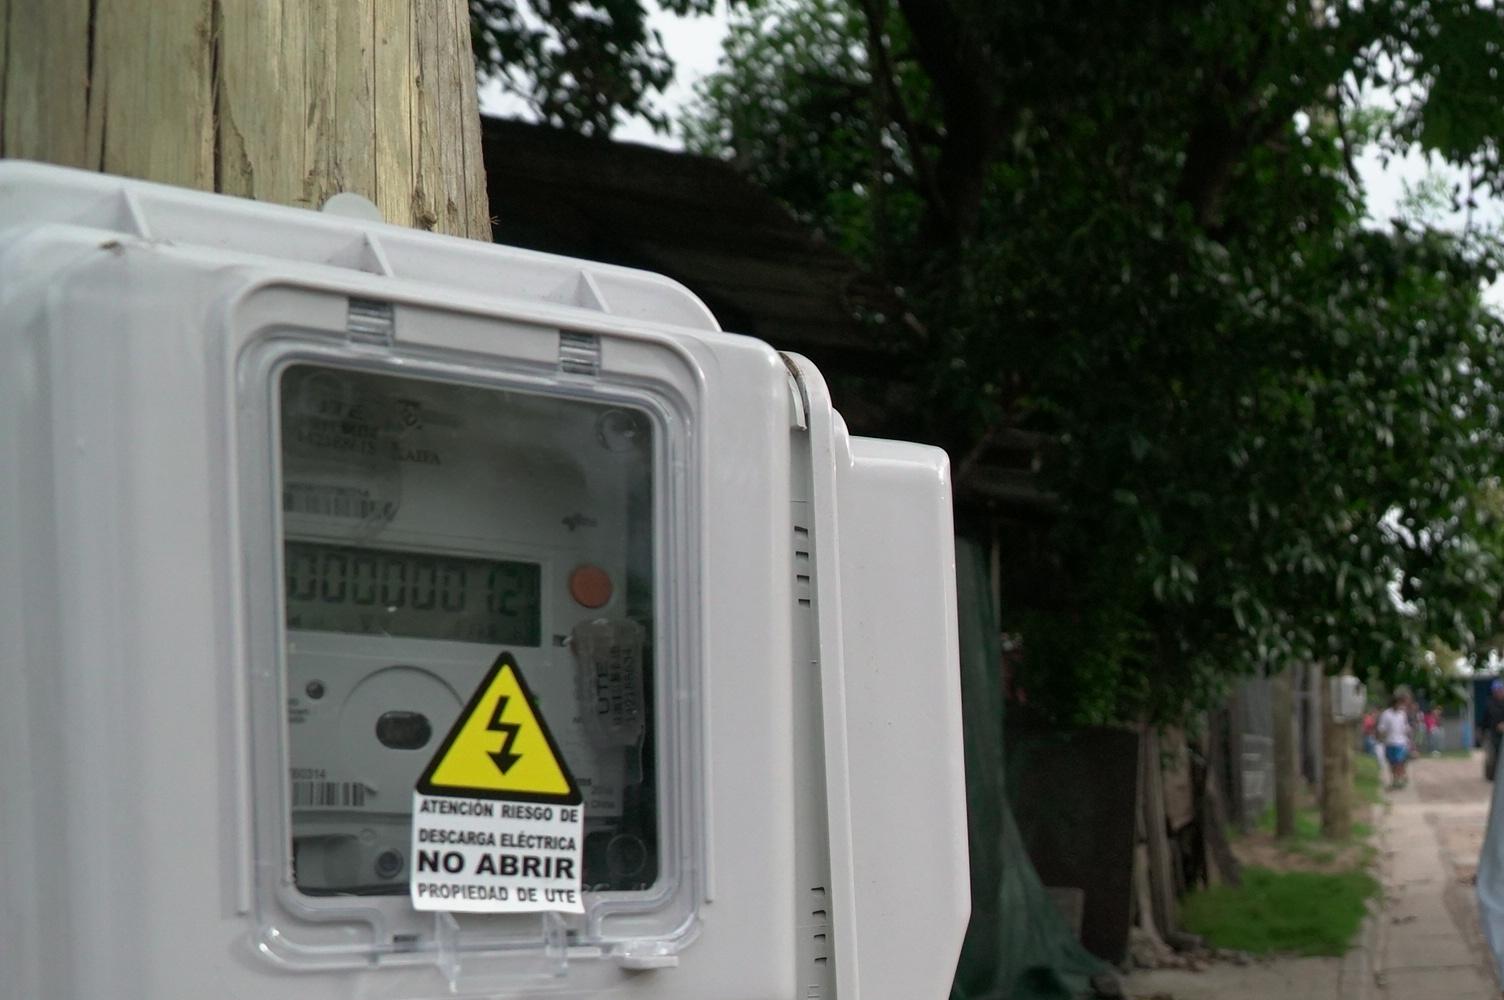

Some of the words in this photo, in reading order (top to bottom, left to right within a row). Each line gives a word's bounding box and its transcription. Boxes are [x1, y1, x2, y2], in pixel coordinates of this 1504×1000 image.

[596, 661, 609, 714] UTE
[420, 799, 493, 818] ATENCIÓN
[502, 804, 552, 821] RIESGO
[560, 809, 578, 823] DE
[419, 828, 496, 846] DESCARGA
[501, 831, 576, 850] ELÉCTRICA
[418, 849, 465, 874] NO
[475, 853, 575, 879] ABRIR
[418, 882, 508, 901] PROPIEDAD
[517, 887, 538, 902] DE
[545, 888, 576, 904] UTE
